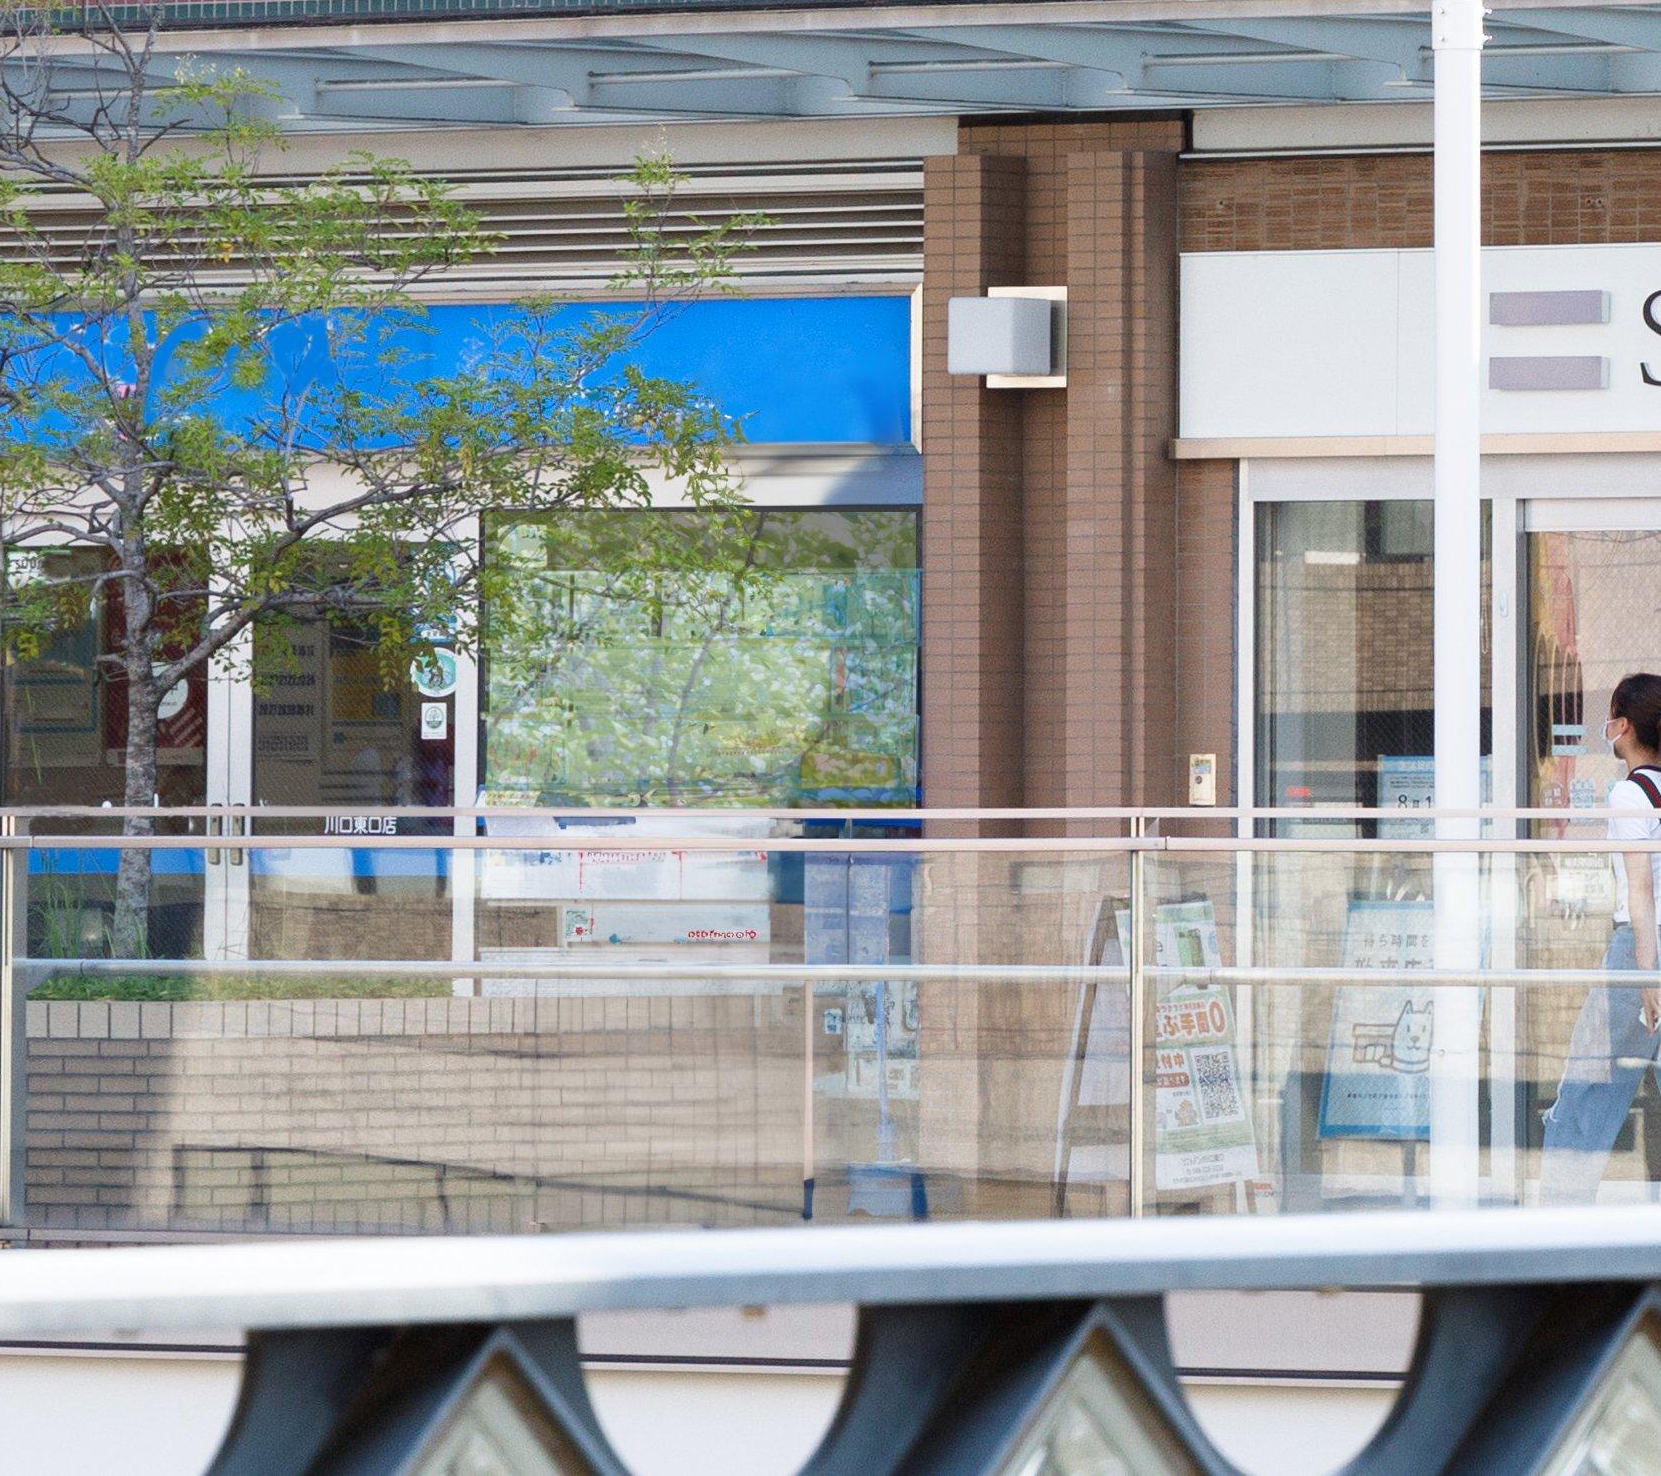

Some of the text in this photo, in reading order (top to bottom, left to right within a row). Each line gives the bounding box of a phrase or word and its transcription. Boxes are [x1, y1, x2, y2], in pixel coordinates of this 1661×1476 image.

[324, 815, 398, 835] 川口東口店
